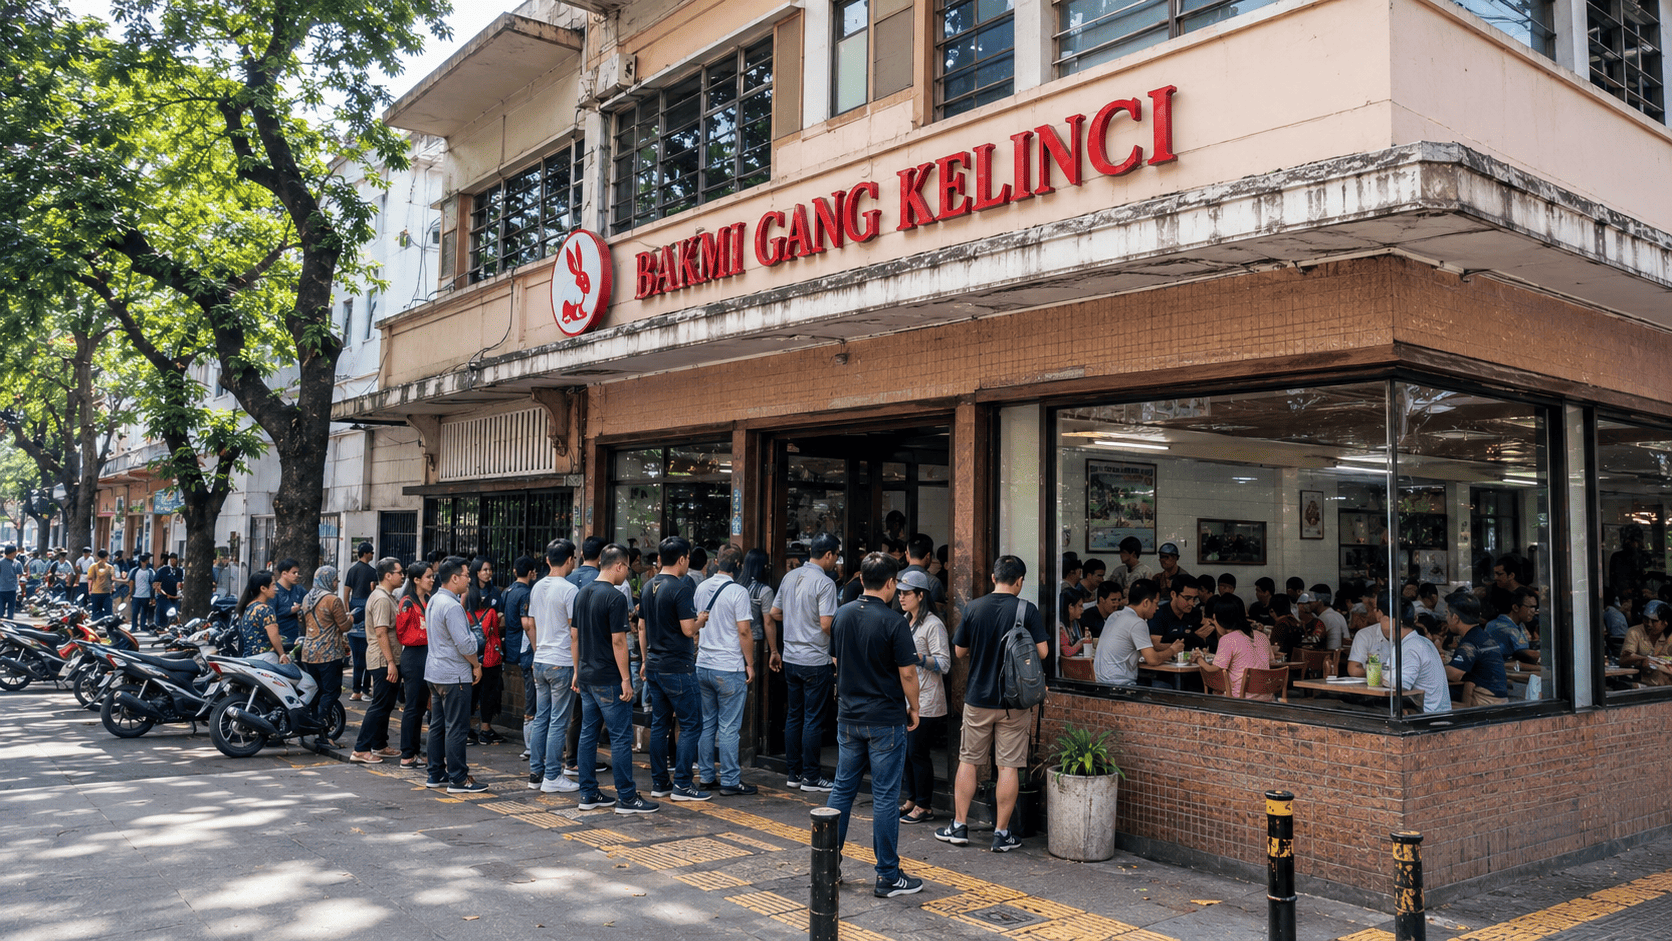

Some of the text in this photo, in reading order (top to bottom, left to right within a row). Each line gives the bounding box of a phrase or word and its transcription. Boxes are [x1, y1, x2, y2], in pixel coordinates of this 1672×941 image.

[634, 84, 1178, 300] BAKMI GANG KELINCI
